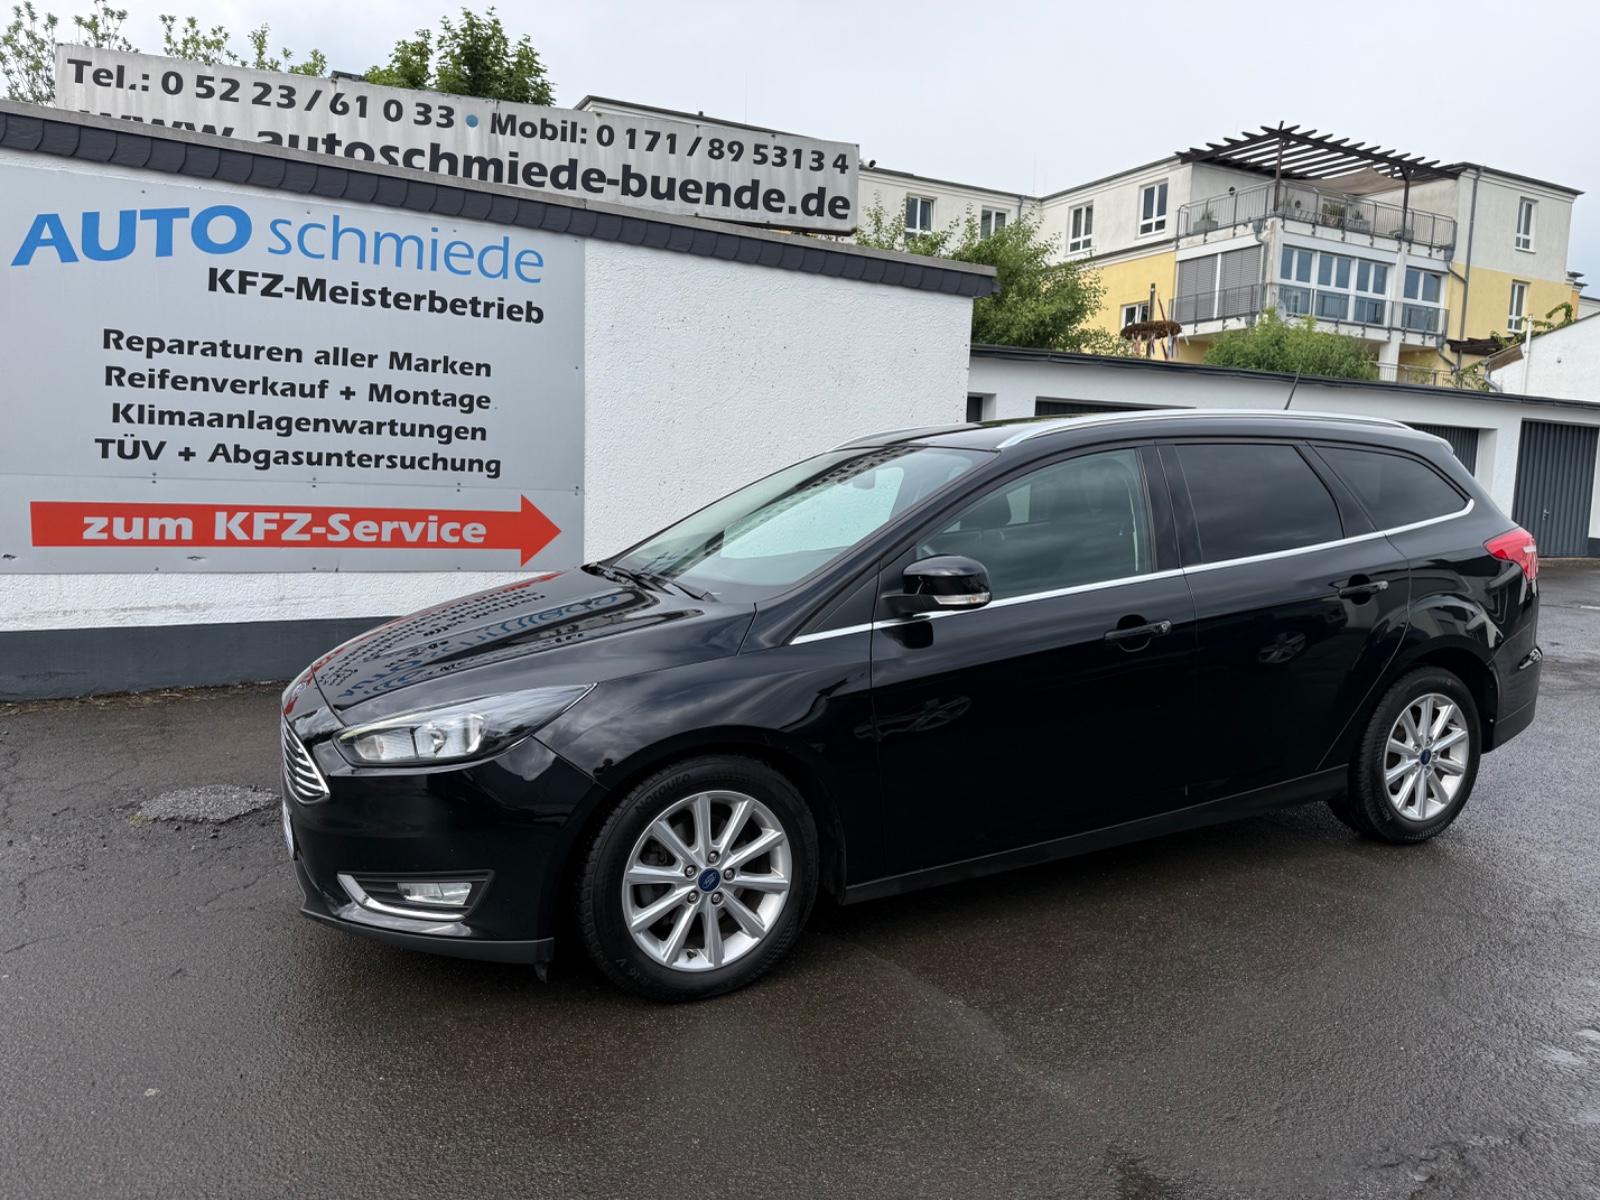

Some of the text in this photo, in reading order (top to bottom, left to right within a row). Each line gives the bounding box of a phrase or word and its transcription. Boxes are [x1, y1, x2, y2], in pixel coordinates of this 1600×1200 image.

[68, 59, 149, 91] Tel.:
[491, 113, 587, 144] Mobil:
[10, 204, 544, 284] AUTO schmiede
[208, 267, 543, 324] KFZ-Meisterbetrieb
[104, 329, 491, 377] Reparaturen aller Marken
[106, 363, 490, 414] Reifenverkauf + Montage
[111, 402, 488, 443] Klimaanlagenwartungen
[95, 434, 501, 479] TÜV + Abgasuntersuchung
[83, 511, 487, 543] zum KFZ-Service
